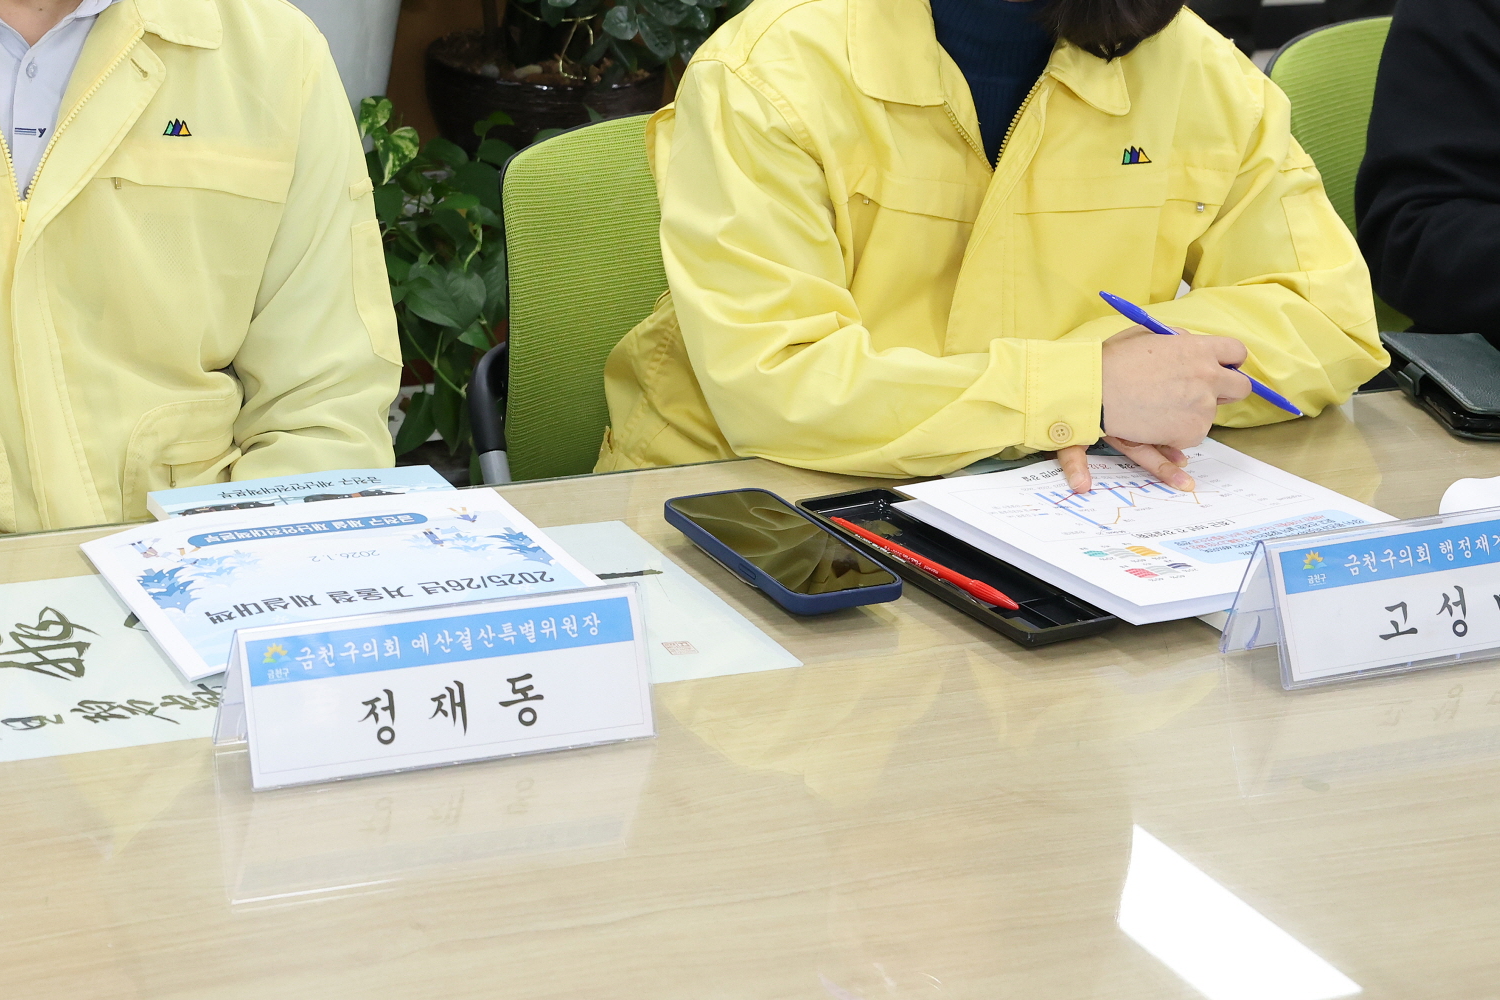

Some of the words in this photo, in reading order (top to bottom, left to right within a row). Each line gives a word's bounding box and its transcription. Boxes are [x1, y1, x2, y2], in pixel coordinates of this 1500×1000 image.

[217, 481, 332, 500] 재난안전대책본부
[338, 476, 382, 486] 금천구
[331, 518, 367, 530] 제설
[368, 514, 416, 526] 금천구
[204, 523, 328, 544] 재난안전대책본부
[308, 548, 381, 563] 2026.1.2
[1343, 542, 1432, 577] 금천구의회
[417, 570, 555, 596] 2025/26년
[1307, 572, 1327, 585] 금천구
[325, 584, 414, 605] 겨울철
[202, 594, 322, 626] 제설대책
[294, 634, 402, 671] 금천구의회
[410, 611, 602, 658] 예산결산특별위원장
[266, 667, 290, 680] 금천구
